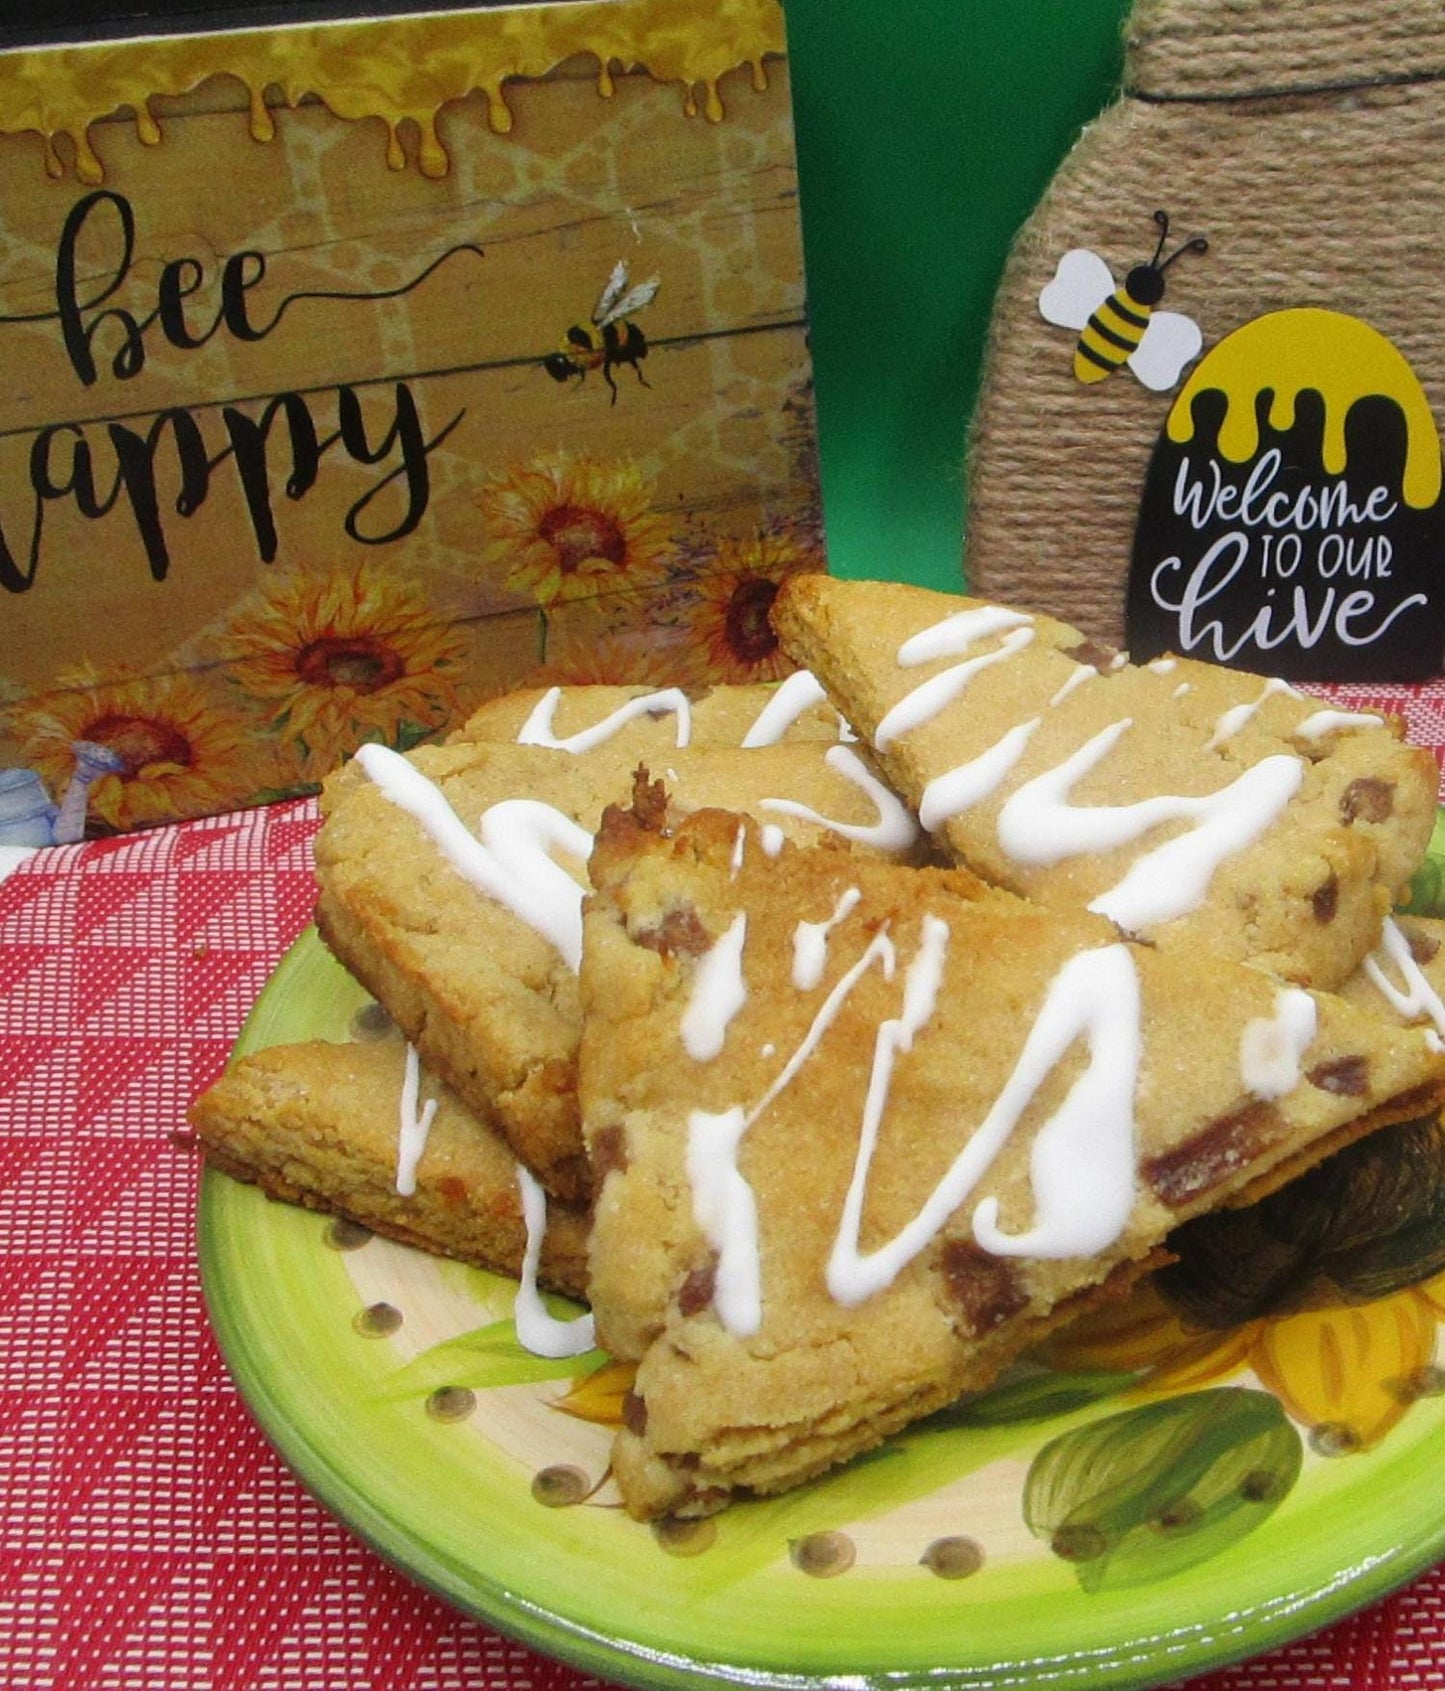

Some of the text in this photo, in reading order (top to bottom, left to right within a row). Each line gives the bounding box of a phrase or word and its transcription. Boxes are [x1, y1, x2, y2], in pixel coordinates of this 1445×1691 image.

[52, 190, 484, 386] bee
[0, 382, 466, 592] appy
[1173, 448, 1397, 529] Welcome
[1150, 531, 1428, 661] hive
[1261, 534, 1393, 580] TO OUR
